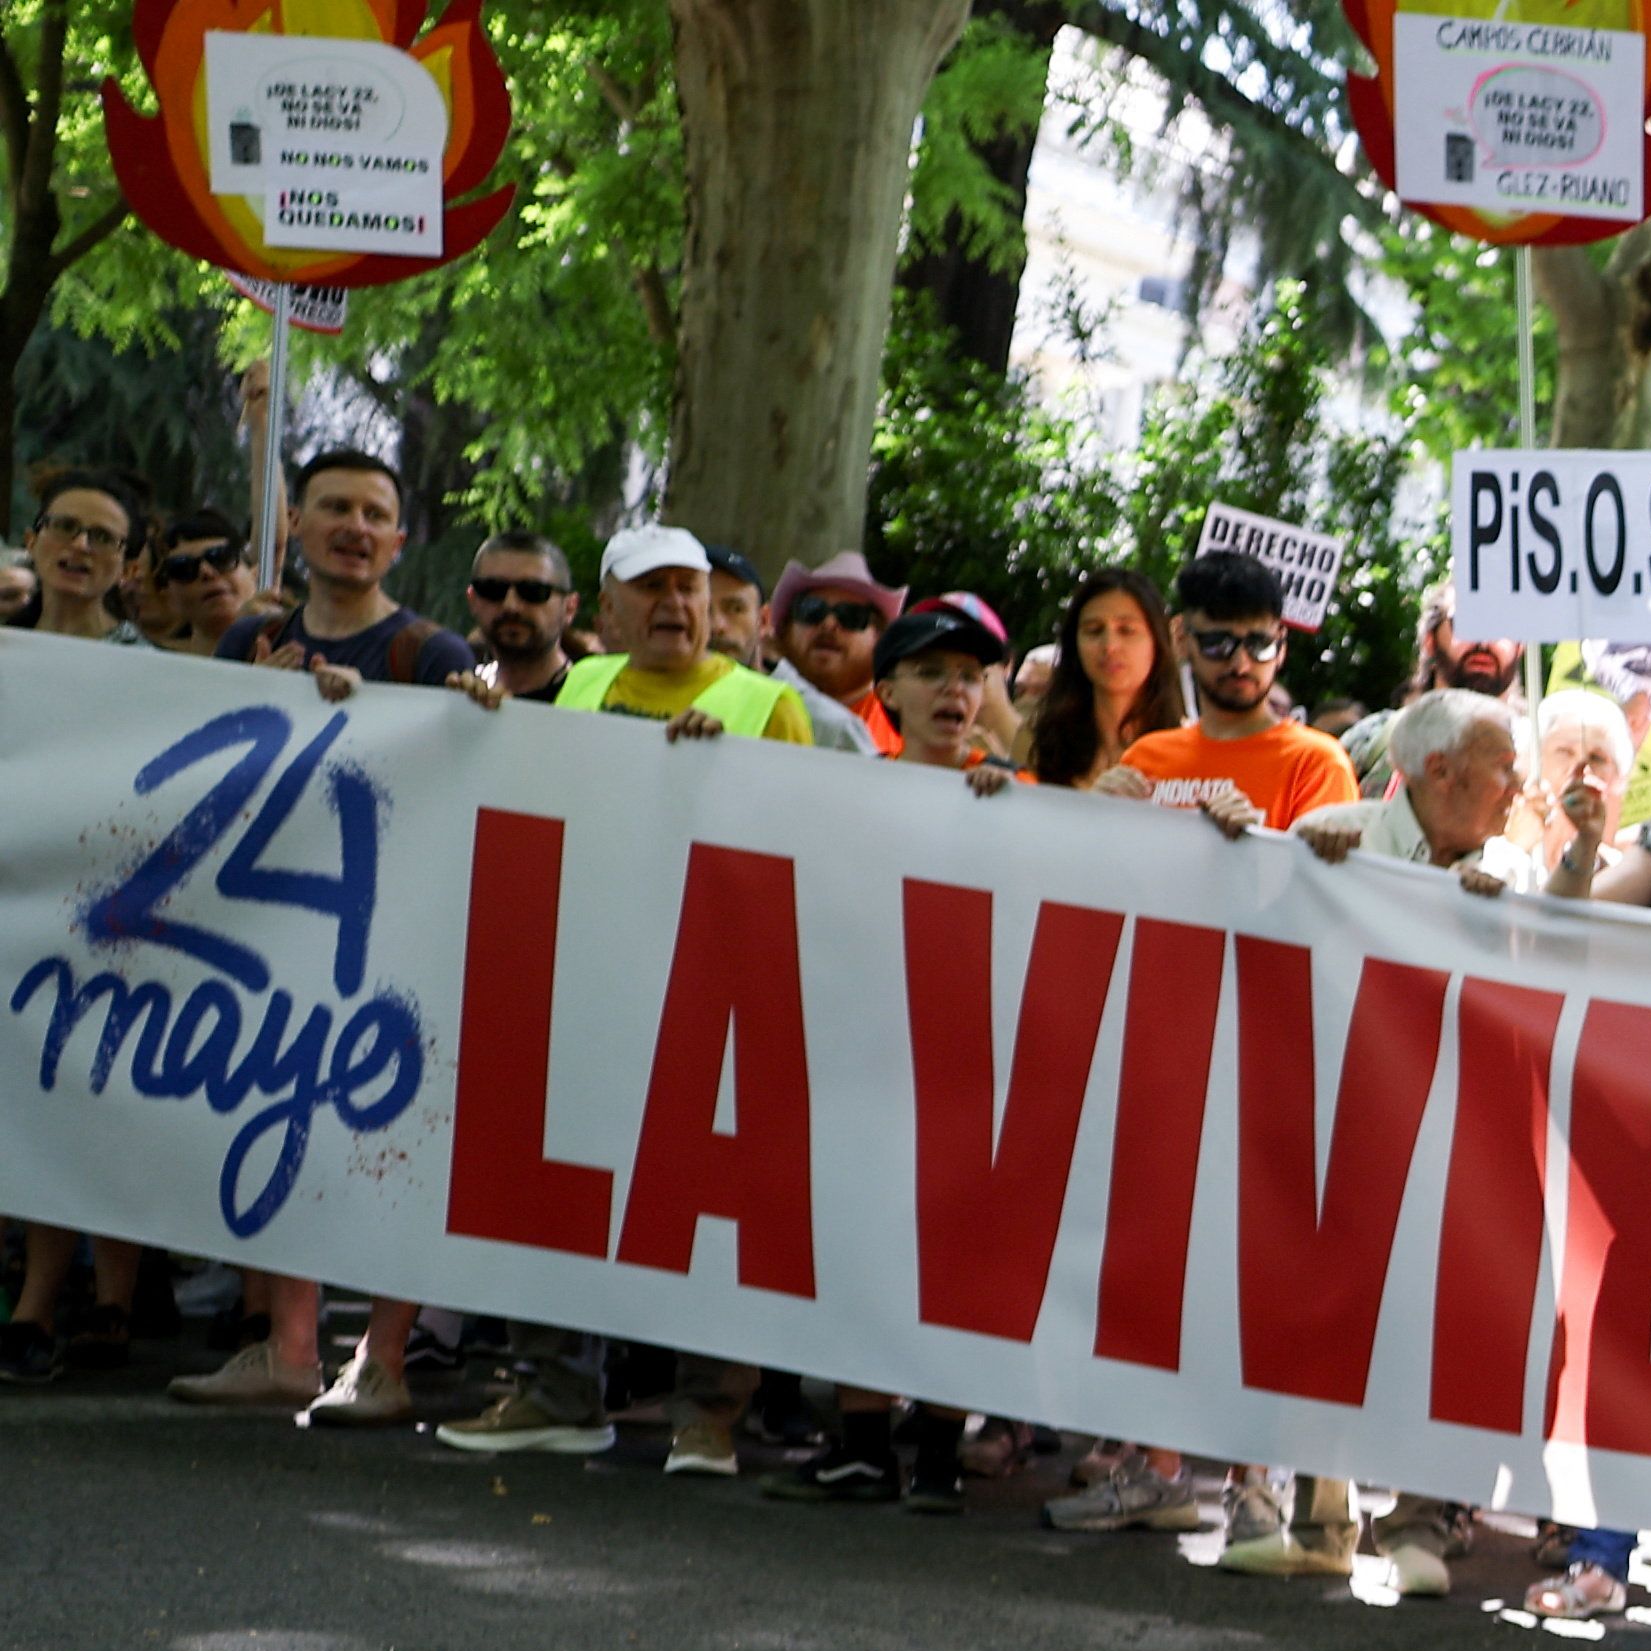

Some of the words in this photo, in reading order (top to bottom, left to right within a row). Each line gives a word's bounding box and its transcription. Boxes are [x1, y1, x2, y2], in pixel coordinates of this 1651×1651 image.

[280, 150, 308, 166] NO
[313, 151, 354, 168] NOS
[359, 153, 430, 174] VAMOS
[278, 208, 427, 236] QUEDAMOS!
[1210, 515, 1336, 574] DERECHO
[82, 704, 391, 997] 24
[445, 805, 817, 1302] LA
